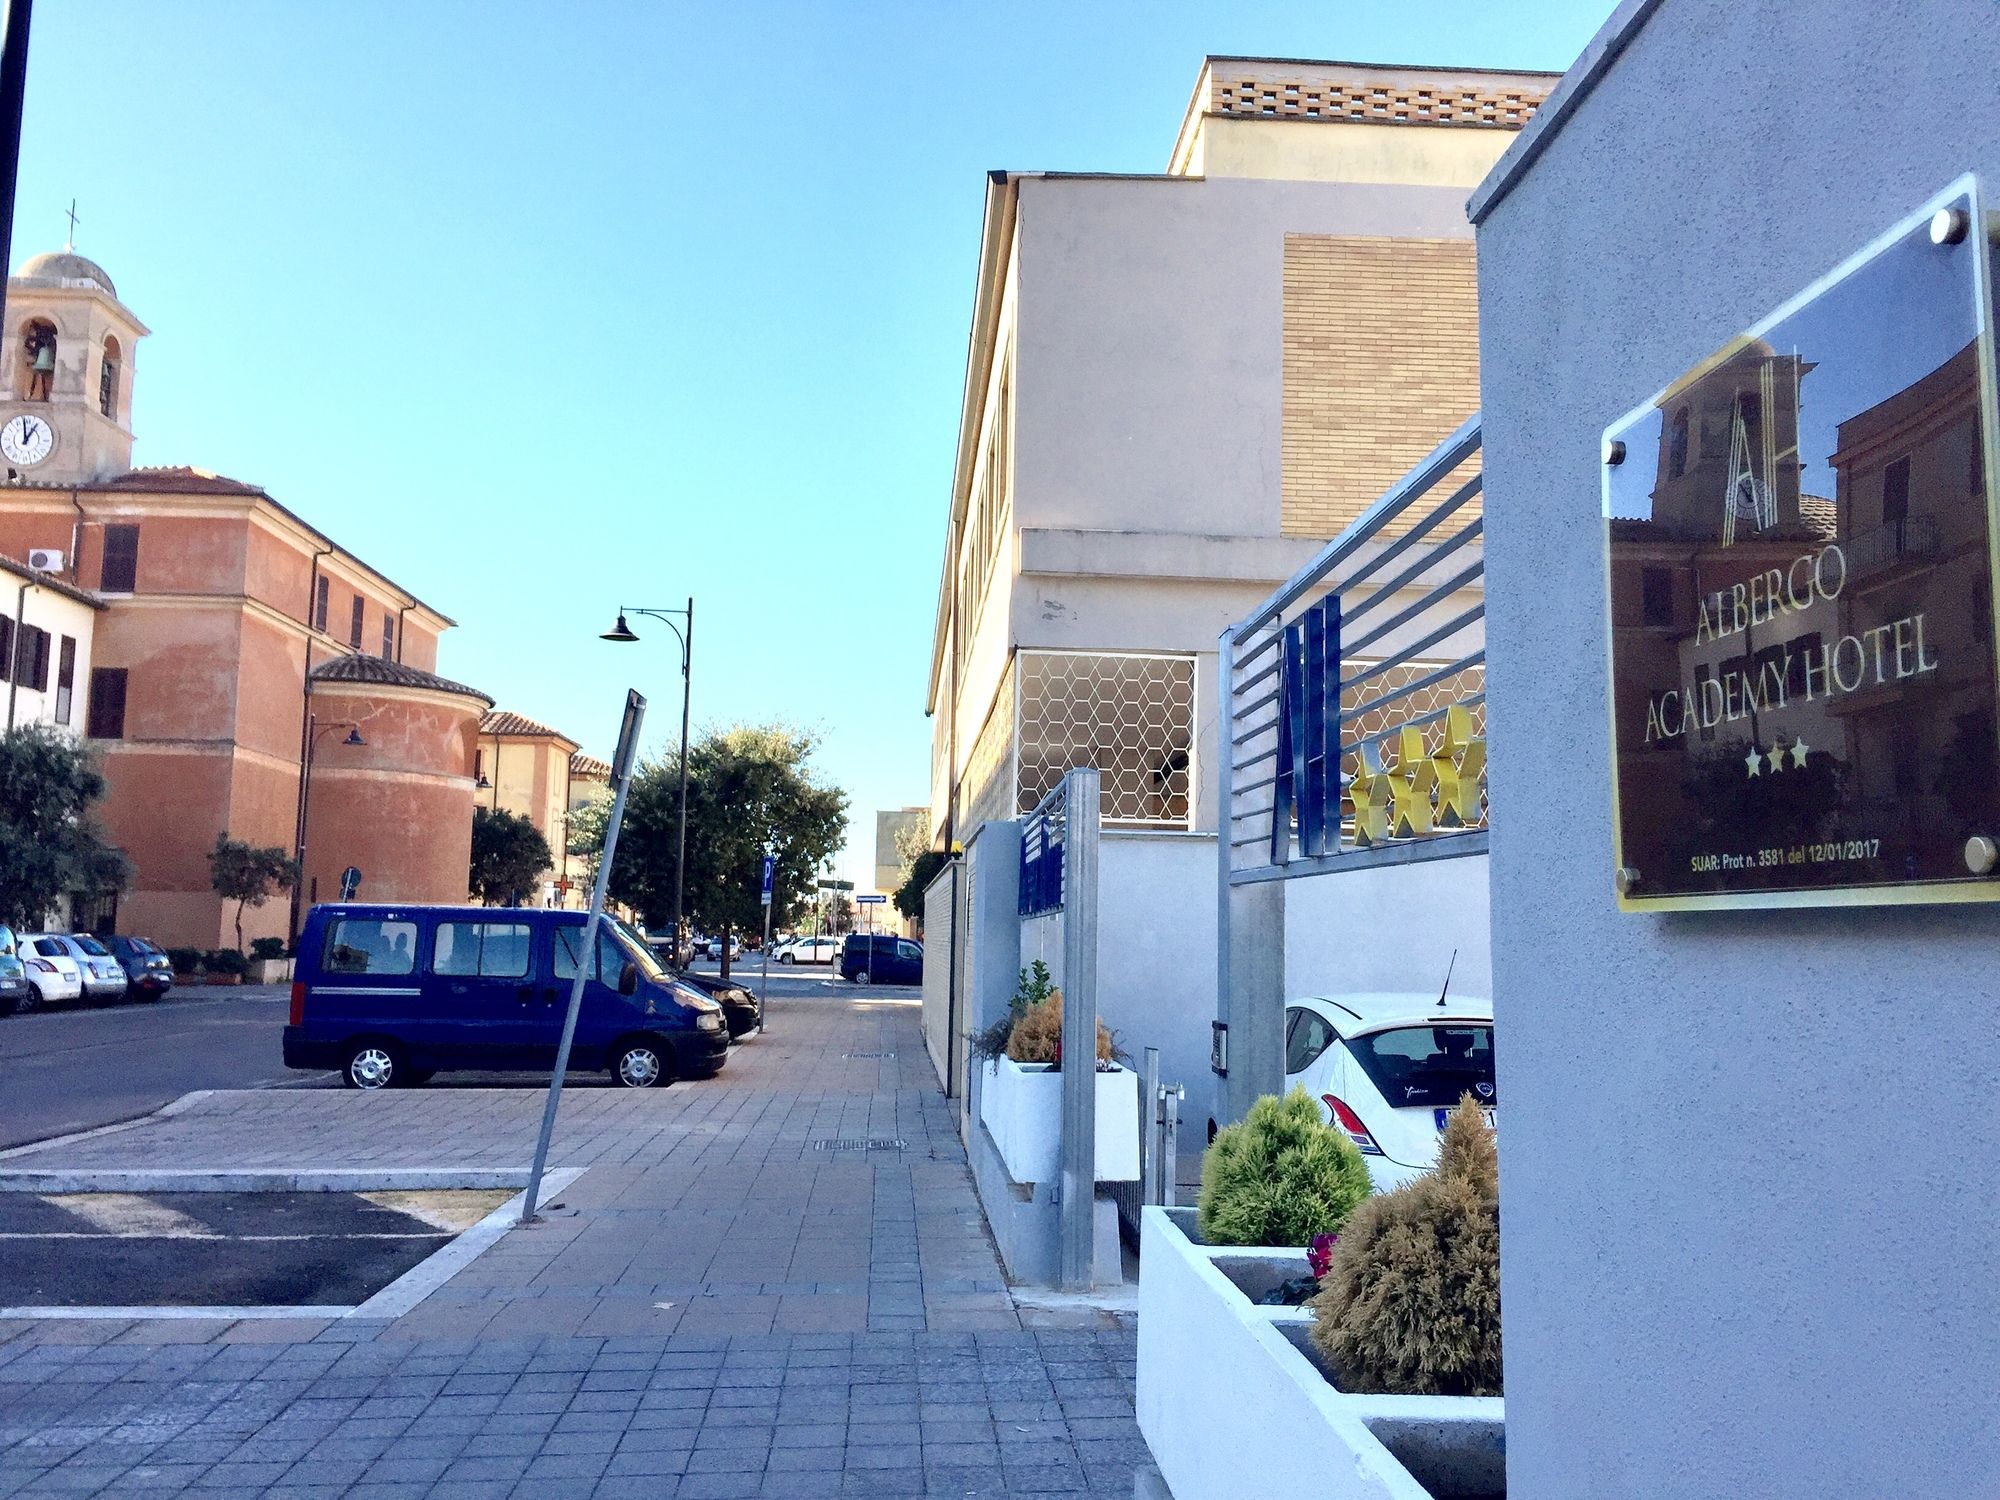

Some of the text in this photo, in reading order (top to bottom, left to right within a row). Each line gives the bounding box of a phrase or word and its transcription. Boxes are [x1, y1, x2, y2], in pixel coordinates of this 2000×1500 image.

[1695, 544, 1846, 647] ALBERGO
[1644, 613, 1938, 743] ACADEMY HOTEL
[764, 861, 771, 888] P
[1691, 838, 1880, 872] SUAR: Prot n. 3581 del 12/01/2017
